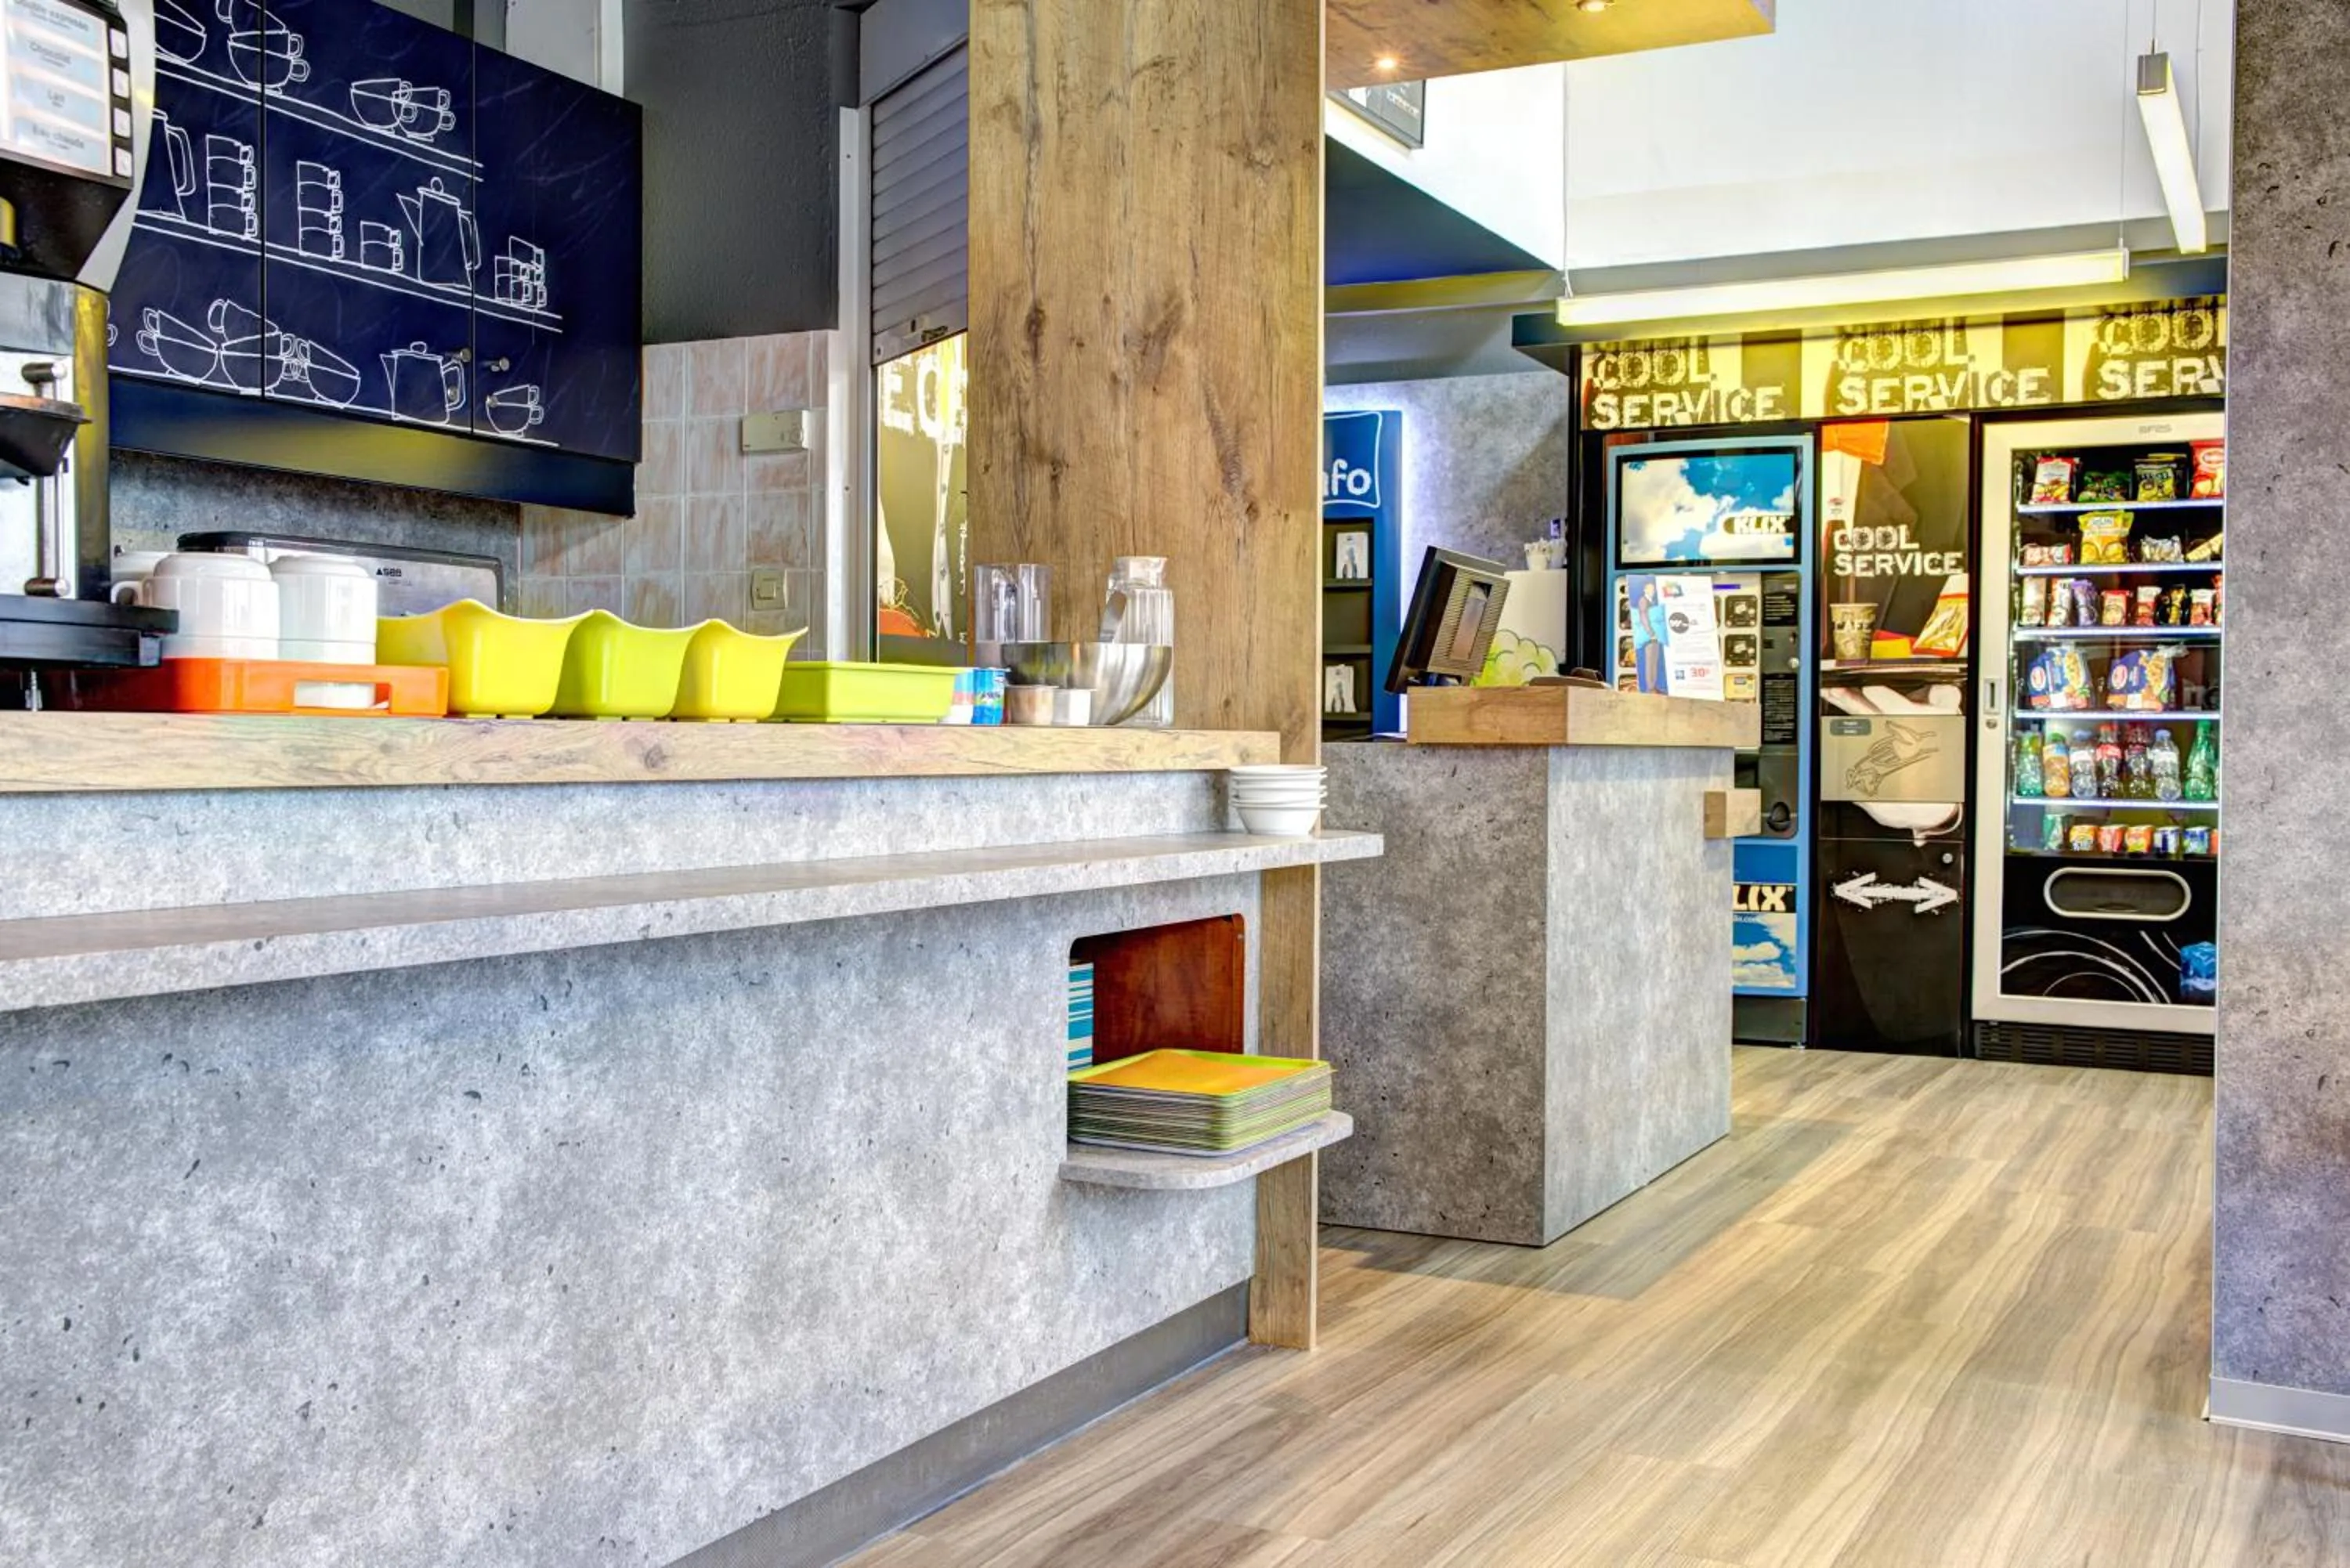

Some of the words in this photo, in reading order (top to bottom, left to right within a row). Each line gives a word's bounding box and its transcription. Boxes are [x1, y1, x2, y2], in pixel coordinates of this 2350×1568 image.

[1593, 345, 1711, 390] COOL
[1837, 324, 1969, 374] COOL
[1591, 385, 1785, 430] SERVICE
[1836, 367, 2050, 415] SERVICE
[1734, 515, 1786, 534] KLIX
[1833, 524, 1920, 551] COOL
[1833, 551, 1964, 577] SERVICE
